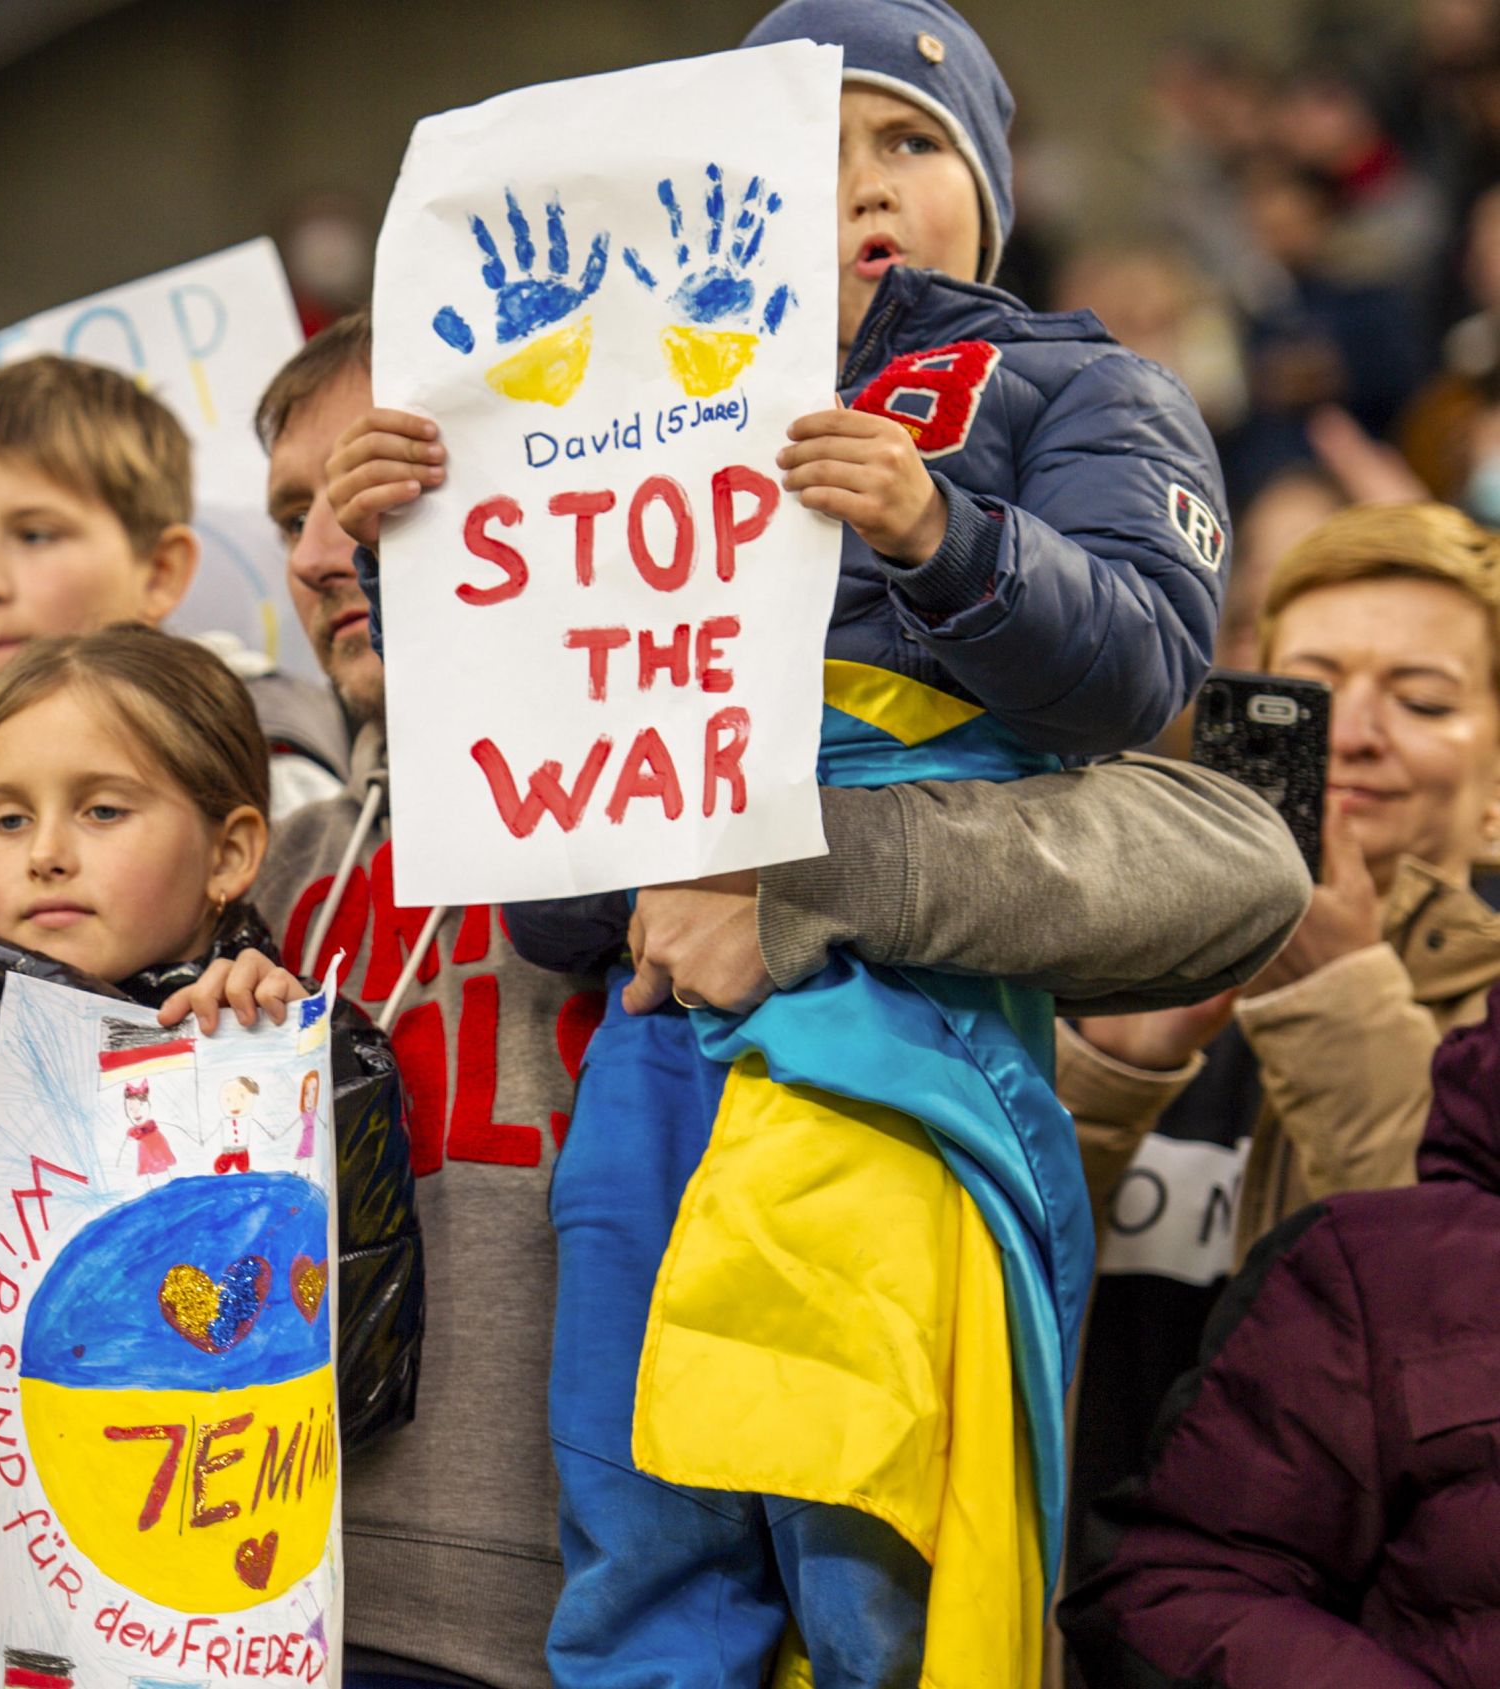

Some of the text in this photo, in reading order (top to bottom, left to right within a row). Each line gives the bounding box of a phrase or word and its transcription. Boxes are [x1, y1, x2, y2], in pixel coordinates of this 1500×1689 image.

[523, 412, 641, 468] David
[455, 464, 781, 607] STOP
[563, 614, 742, 702] THE
[470, 705, 752, 839] WAR
